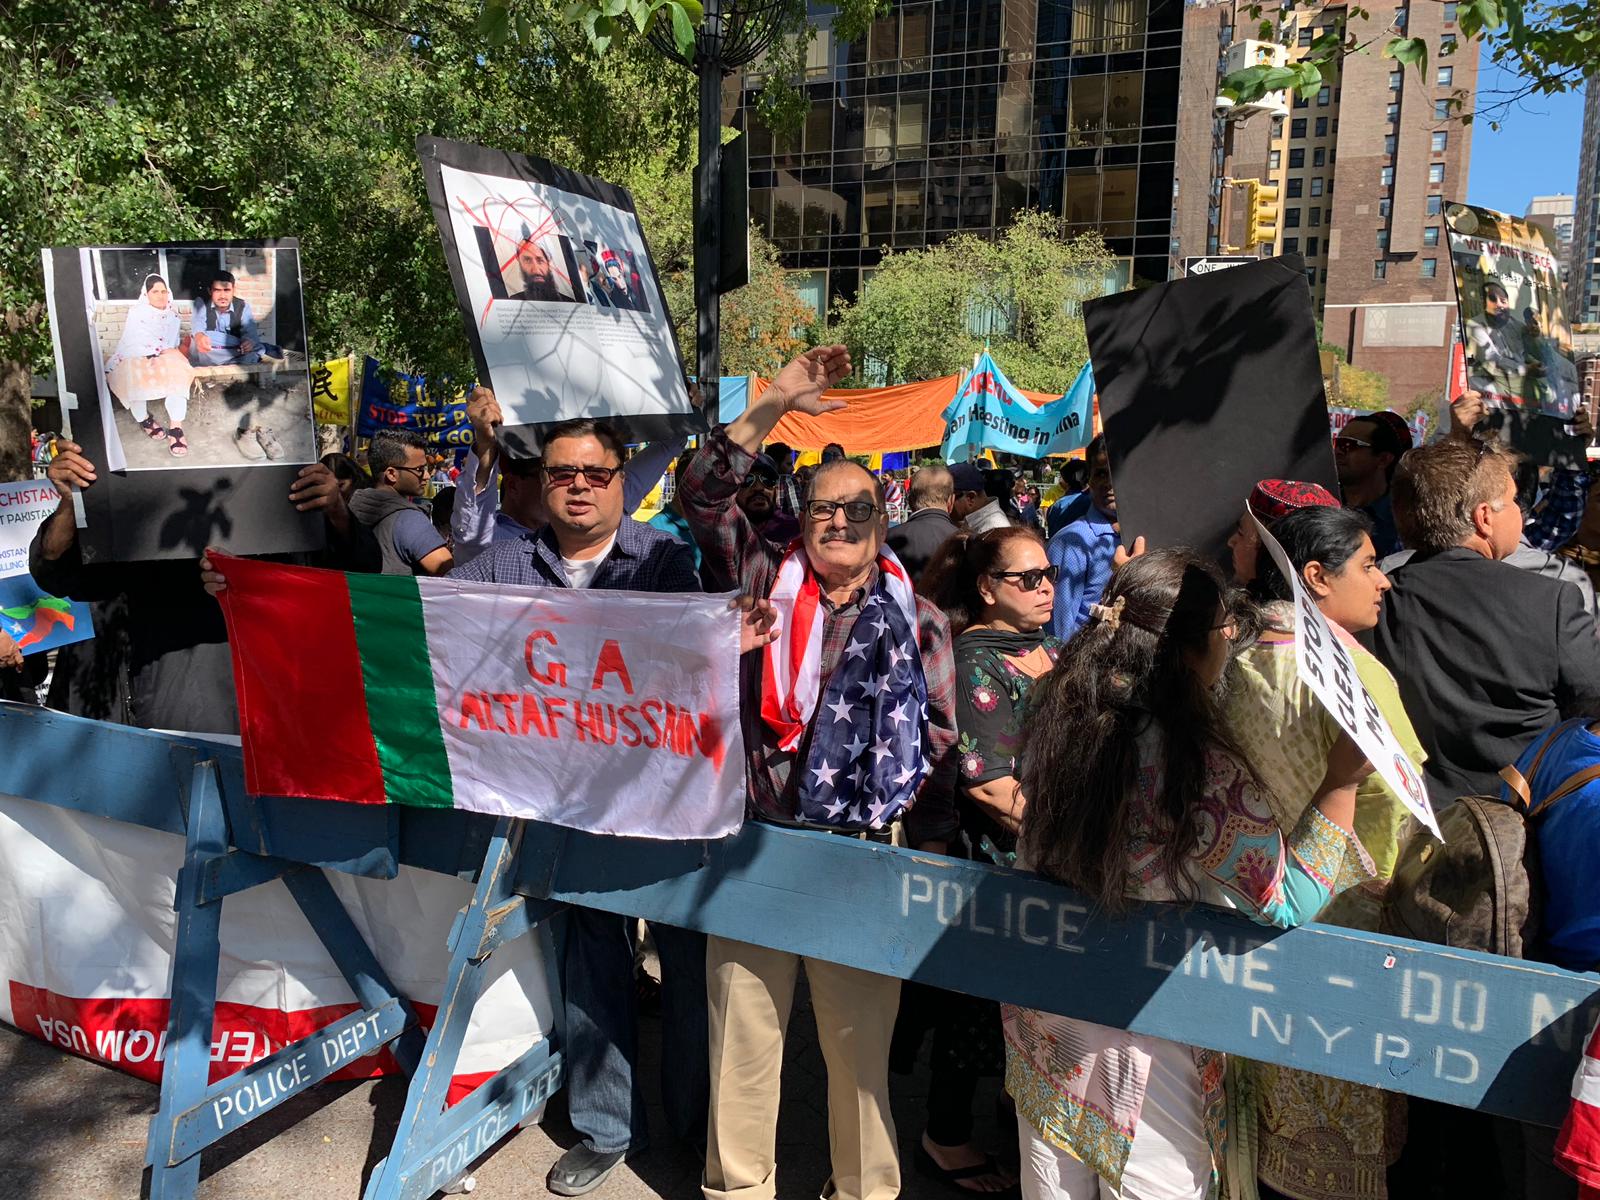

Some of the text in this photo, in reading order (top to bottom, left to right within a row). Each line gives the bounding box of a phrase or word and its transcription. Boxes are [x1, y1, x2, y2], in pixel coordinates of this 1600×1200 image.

[1197, 263, 1216, 273] ONE
[1466, 239, 1552, 270] WE WANT PEACE
[369, 403, 473, 428] STOP THE P
[1034, 427, 1051, 446] in
[524, 629, 634, 695] G A
[460, 691, 568, 738] ALTAF
[902, 872, 1087, 953] POLICE
[1146, 920, 1278, 993] LINE
[1401, 969, 1488, 1034] DO
[36, 1014, 90, 1054] USA
[213, 1012, 388, 1130] POLICE DEPT.
[431, 1102, 511, 1188] POLICE
